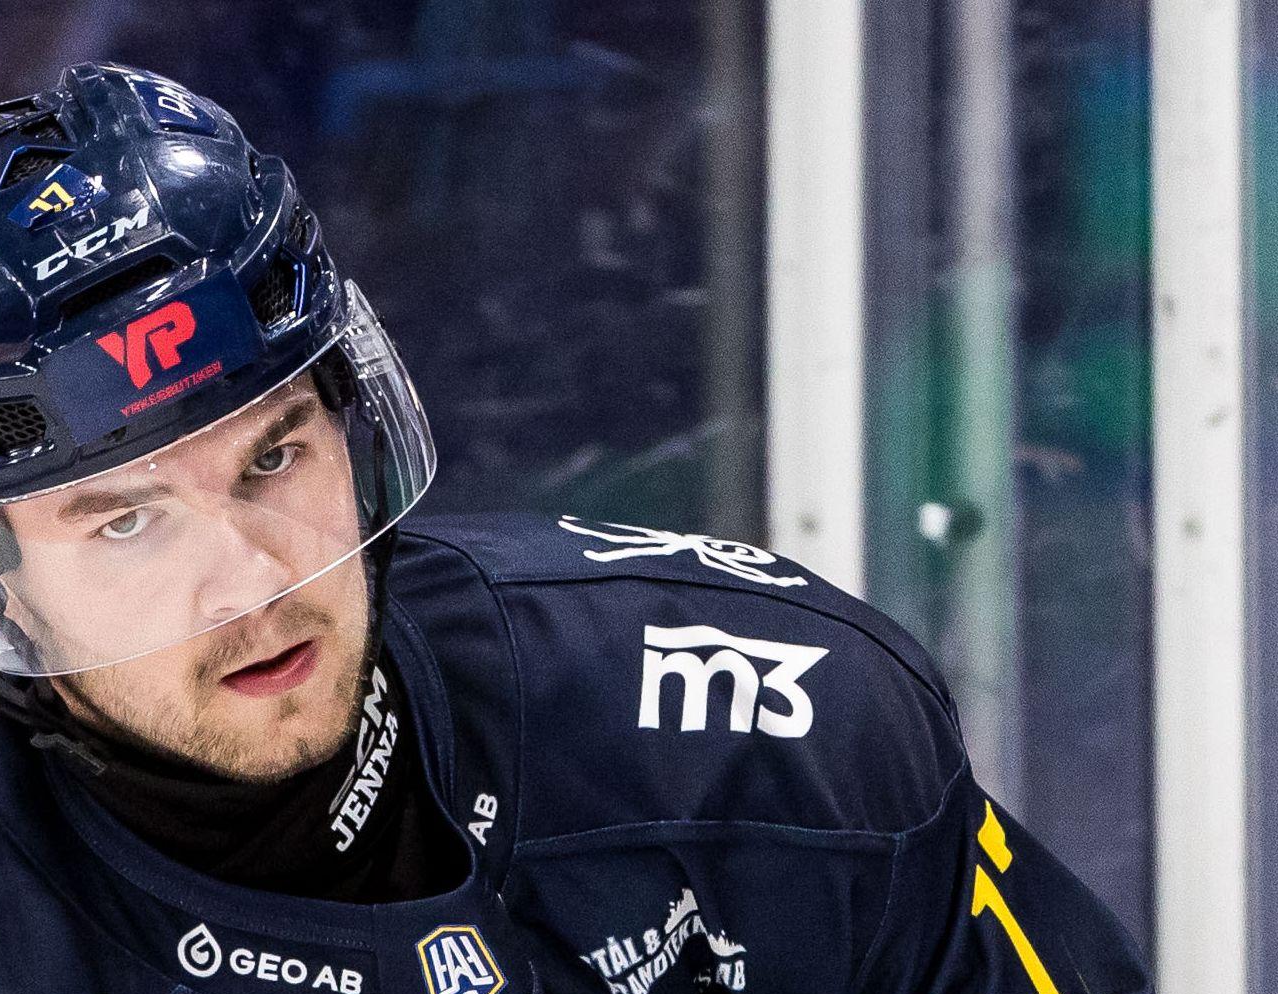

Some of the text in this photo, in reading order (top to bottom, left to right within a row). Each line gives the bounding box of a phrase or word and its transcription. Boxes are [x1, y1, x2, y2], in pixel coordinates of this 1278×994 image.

[29, 181, 76, 212] 17
[33, 204, 150, 281] CCM
[95, 300, 197, 390] YP
[638, 624, 831, 738] m3
[229, 948, 308, 984] GEO
